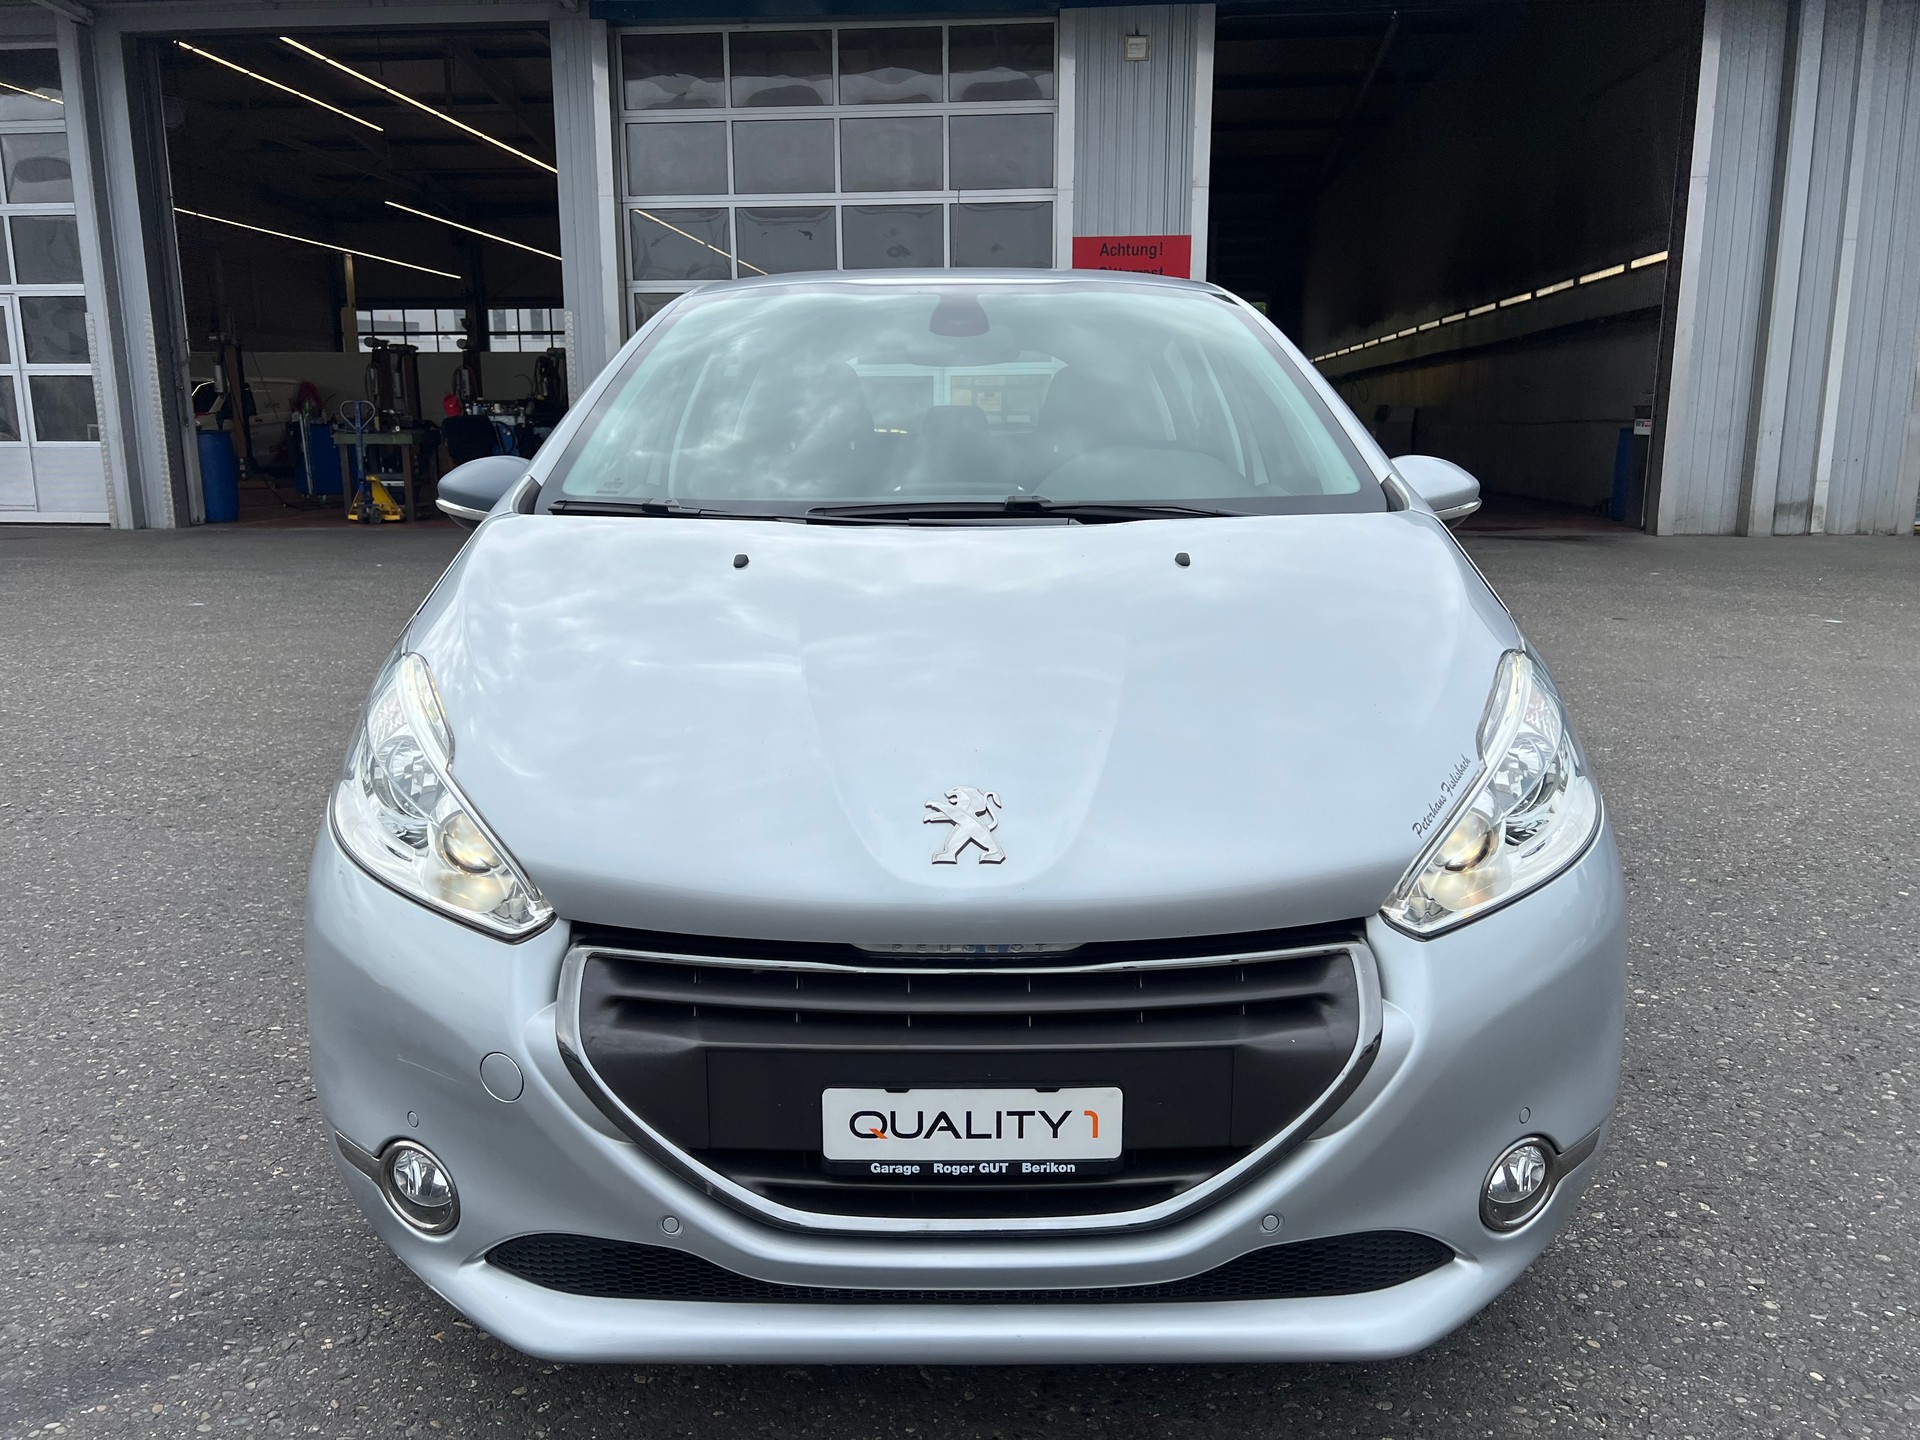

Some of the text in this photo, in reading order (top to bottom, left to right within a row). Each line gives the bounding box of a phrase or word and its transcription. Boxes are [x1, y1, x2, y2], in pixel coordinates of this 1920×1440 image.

[1099, 242, 1163, 259] Achtung!
[1412, 795, 1447, 838] Peterhans
[849, 1110, 1073, 1139] QUALITY
[870, 1162, 1076, 1175] Garage Roger GUT Berikon
